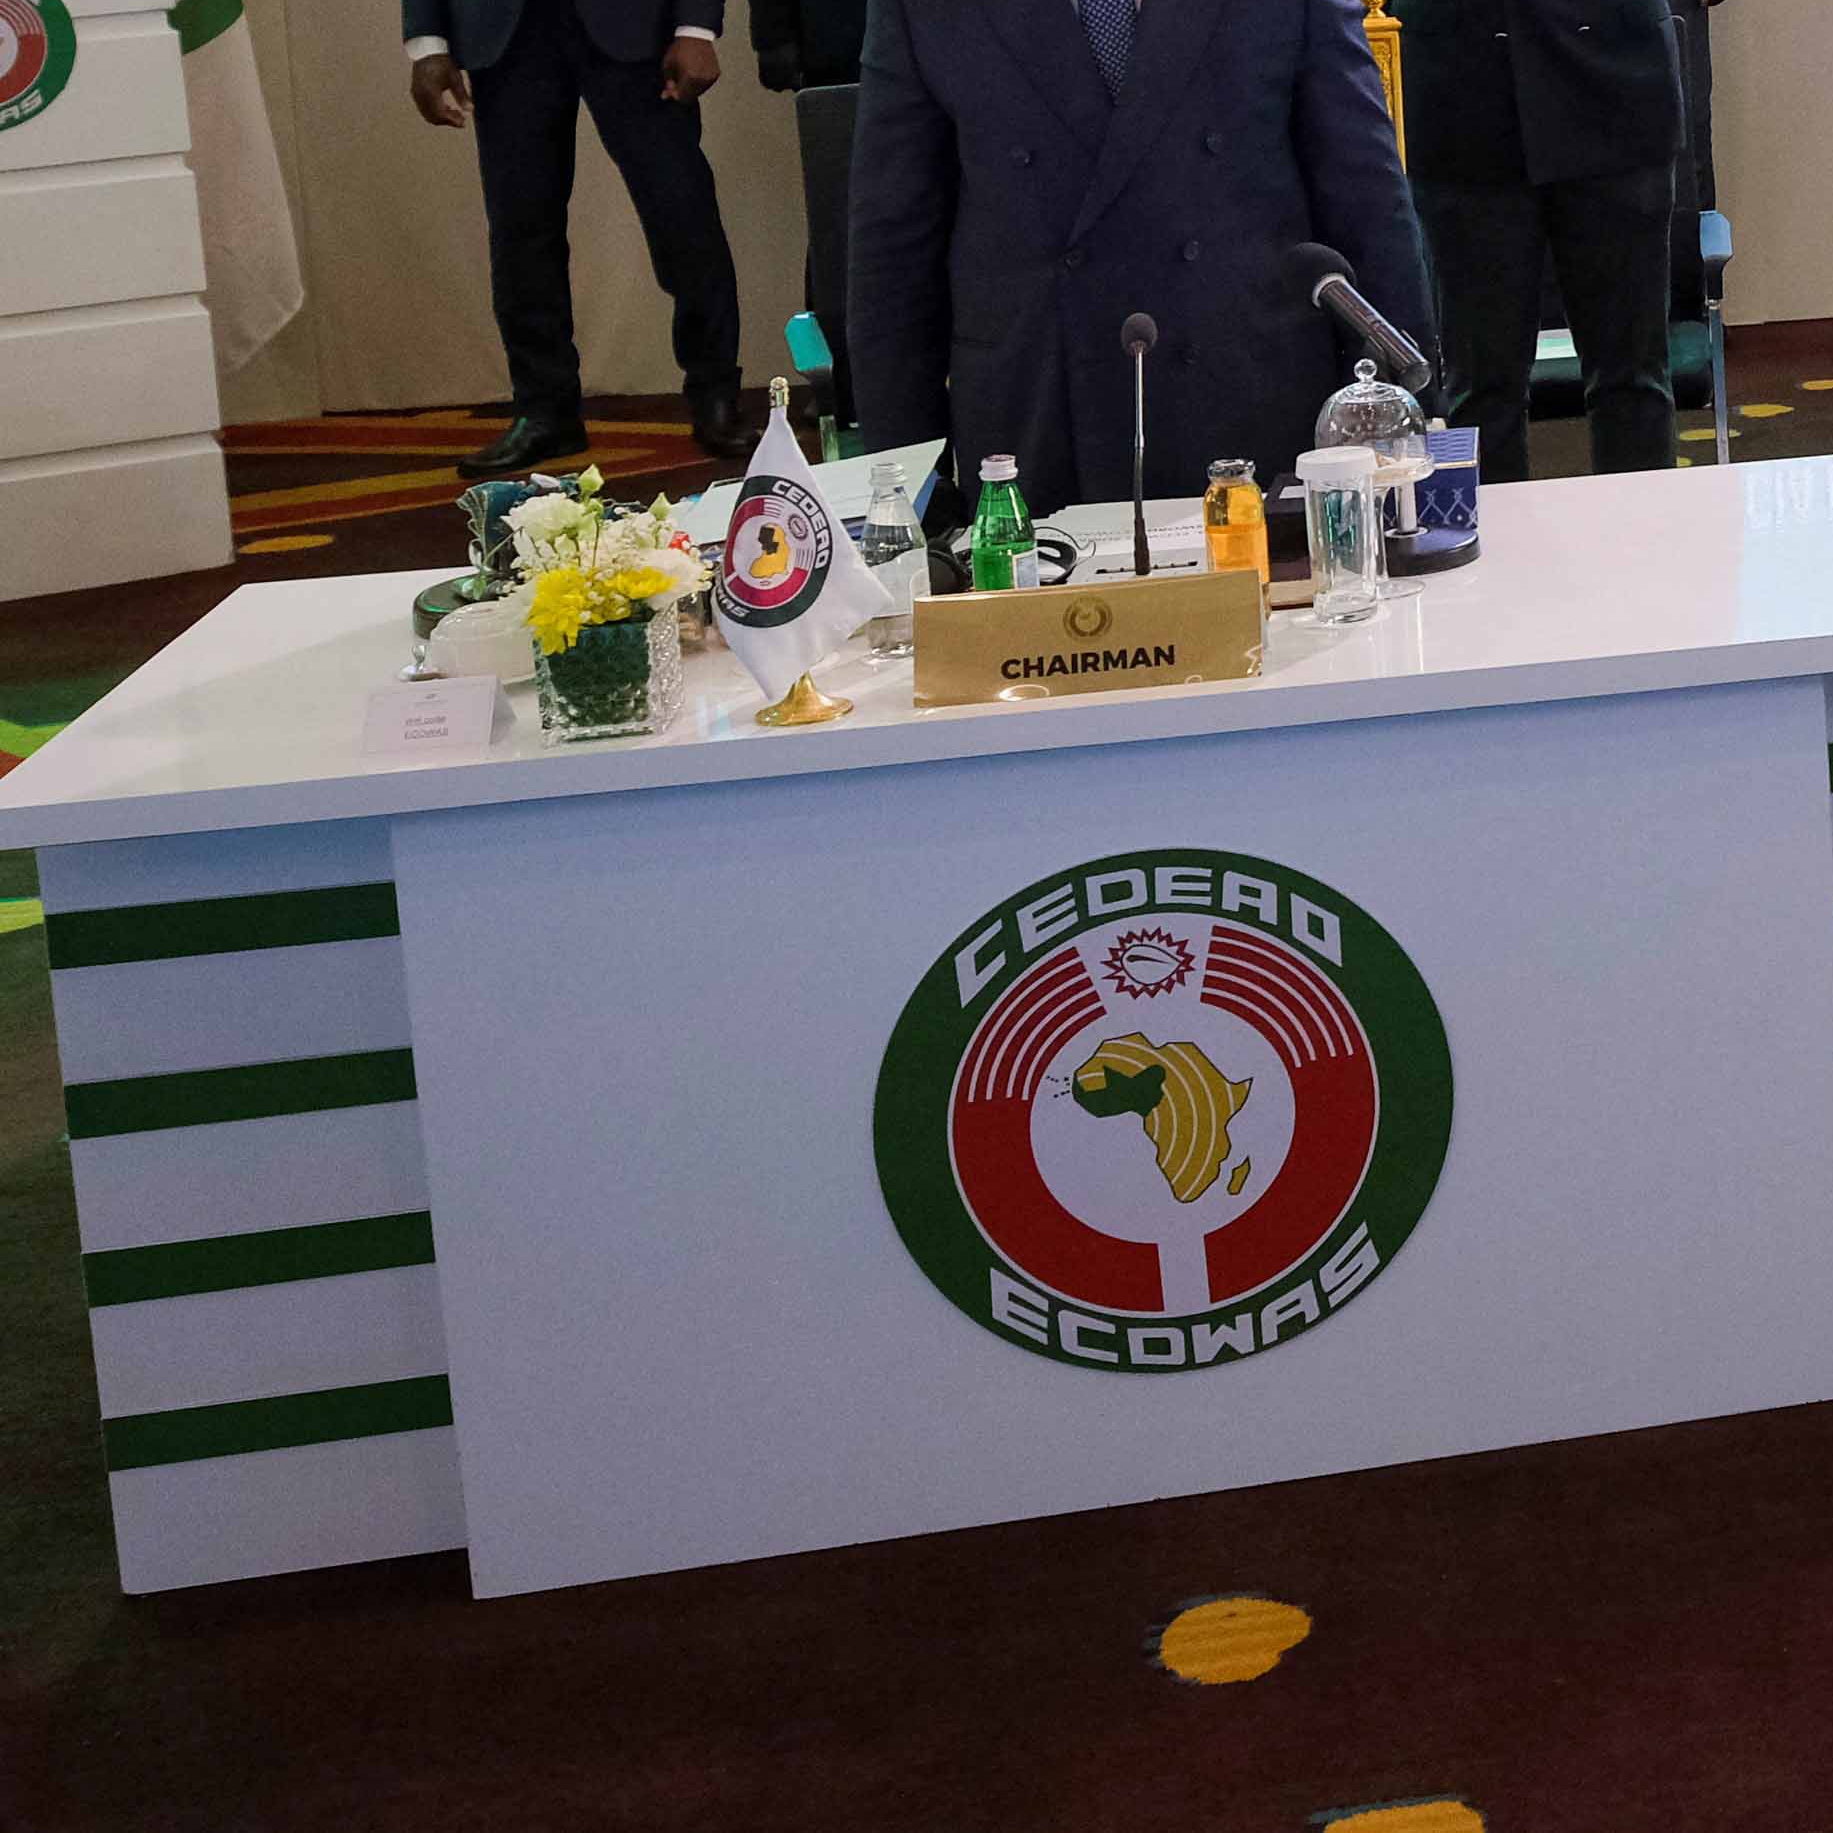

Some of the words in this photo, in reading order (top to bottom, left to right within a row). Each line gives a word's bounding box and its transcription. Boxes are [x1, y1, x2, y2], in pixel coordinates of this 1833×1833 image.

[771, 480, 832, 569] CEDEAO
[1001, 645, 1176, 680] CHAIRMAN
[954, 867, 1343, 1008] CEDEAO
[989, 1221, 1380, 1366] ECOWAS
